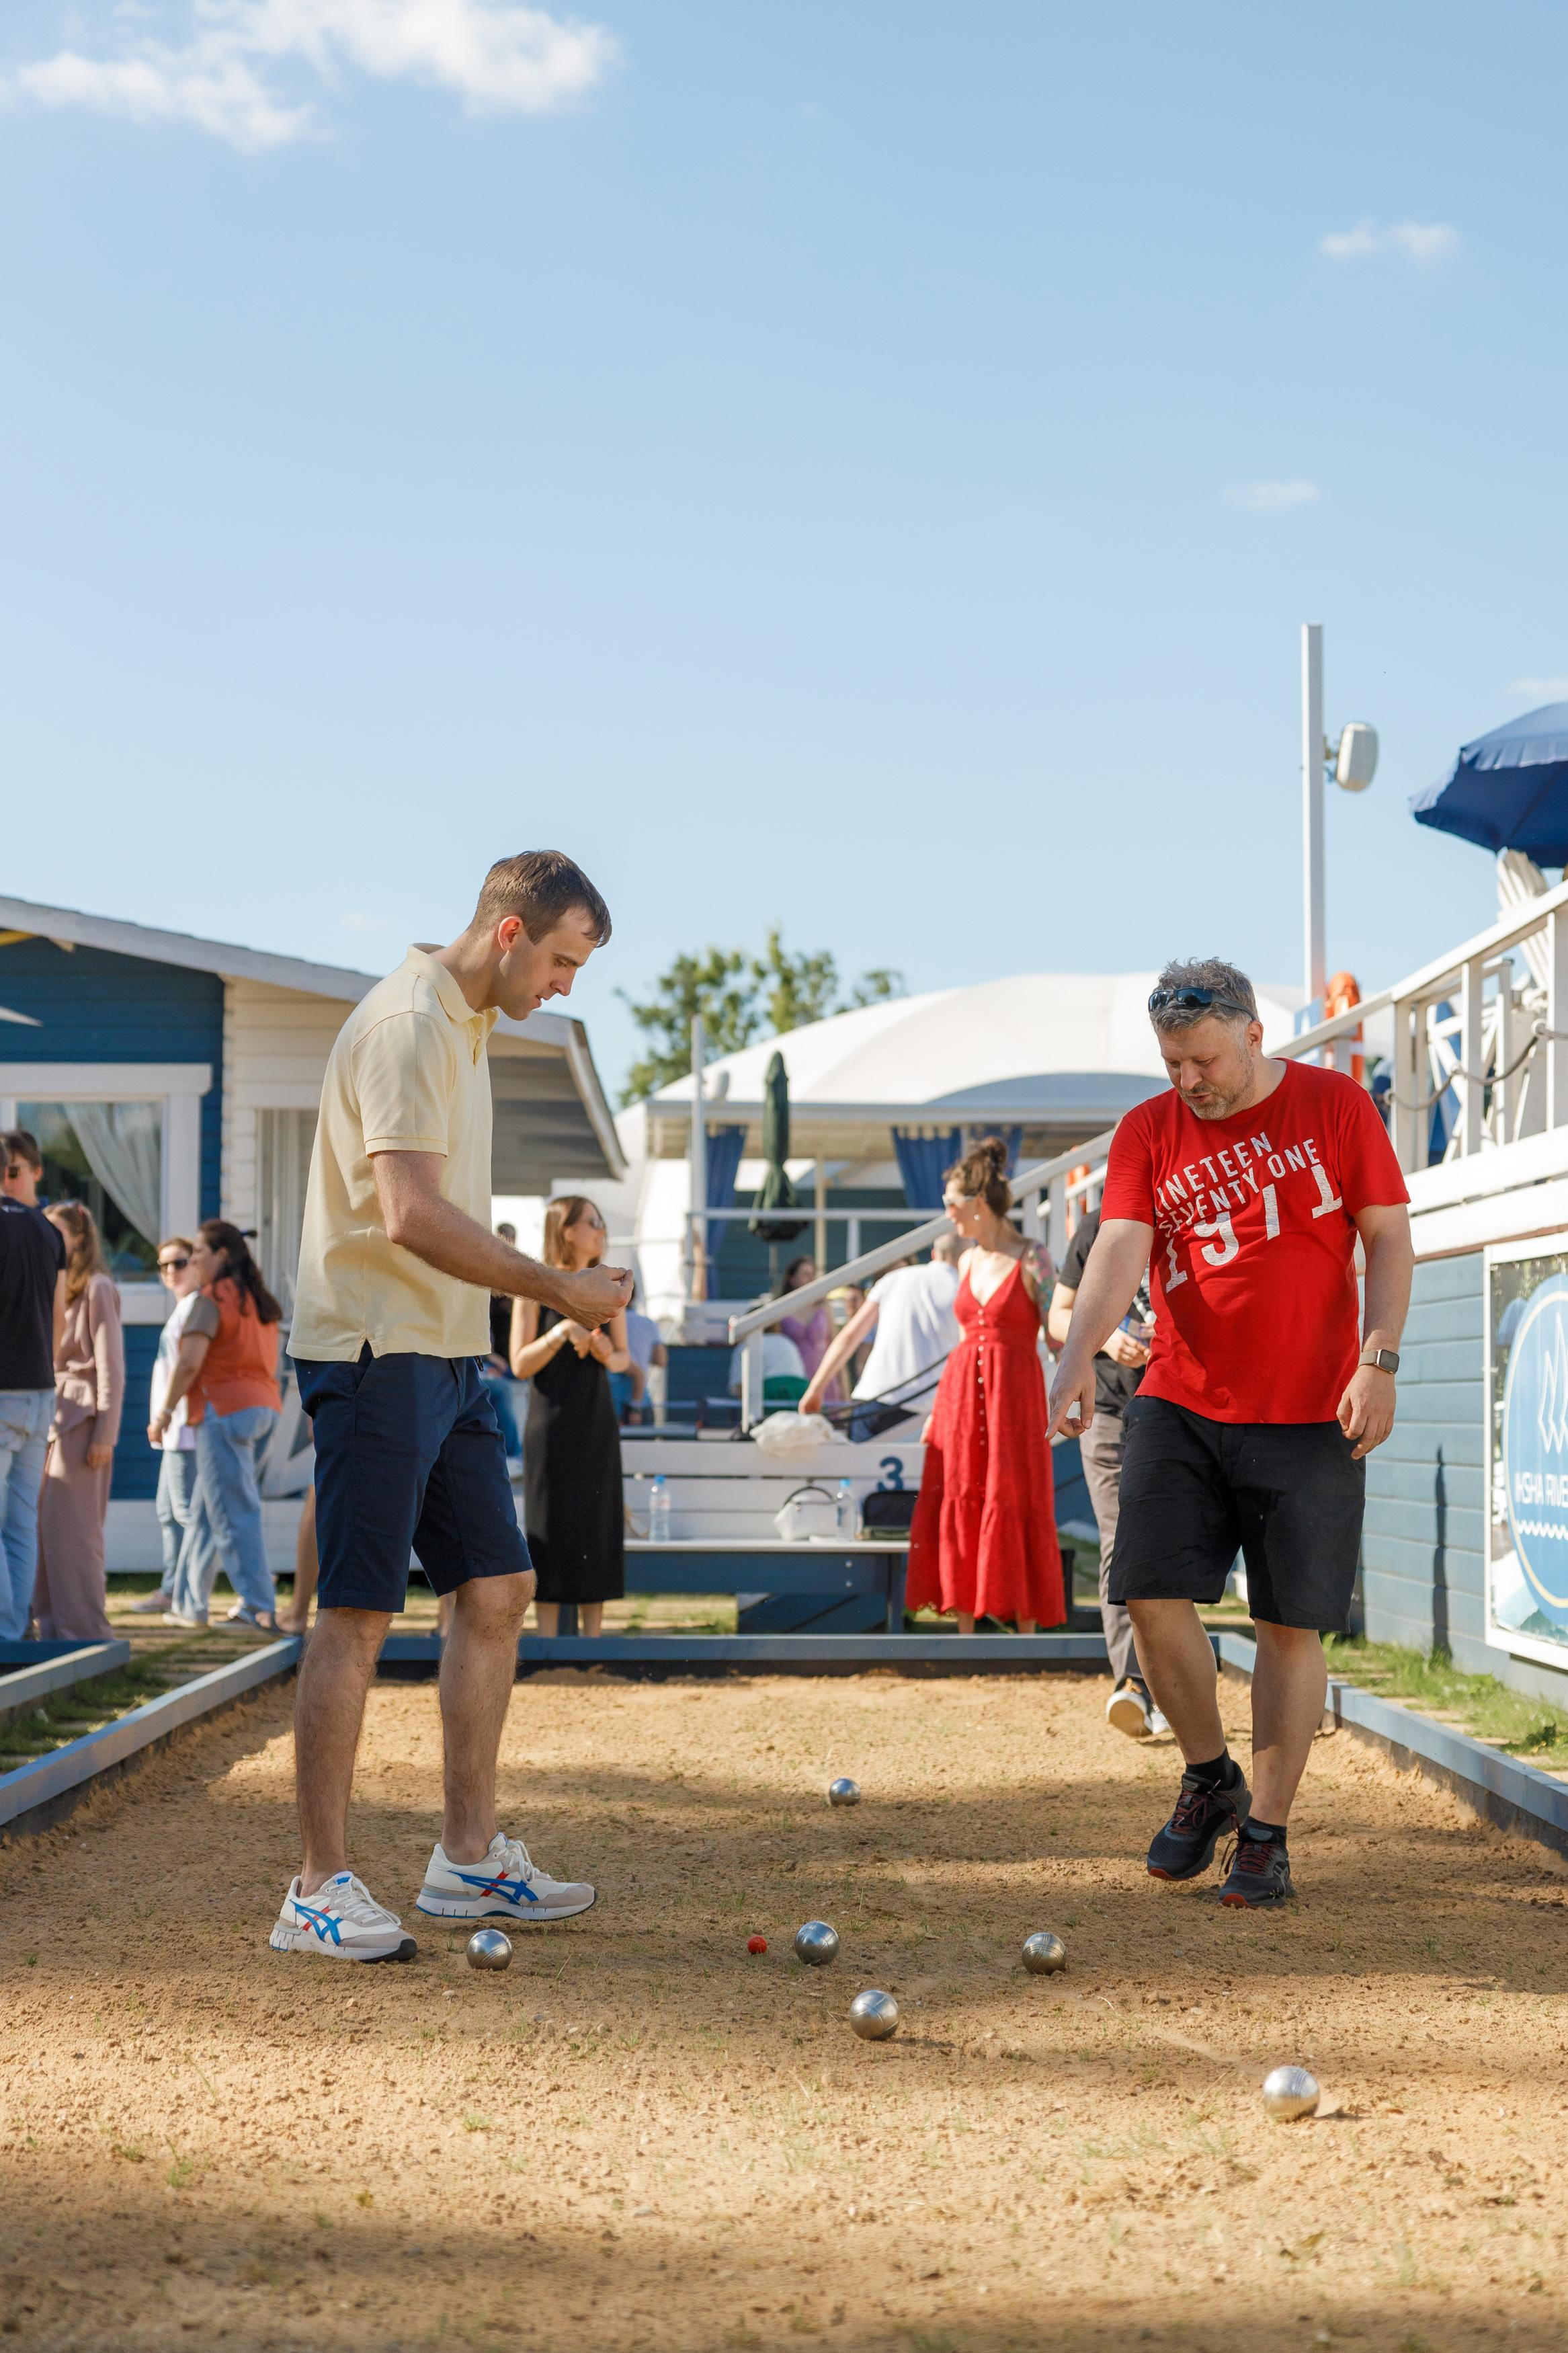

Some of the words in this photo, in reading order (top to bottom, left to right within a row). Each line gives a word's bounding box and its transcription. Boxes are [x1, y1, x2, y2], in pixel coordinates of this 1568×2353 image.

[1159, 1167, 1260, 1238] SEVENTY
[1267, 1138, 1321, 1179] ONE
[877, 1456, 903, 1492] 3
